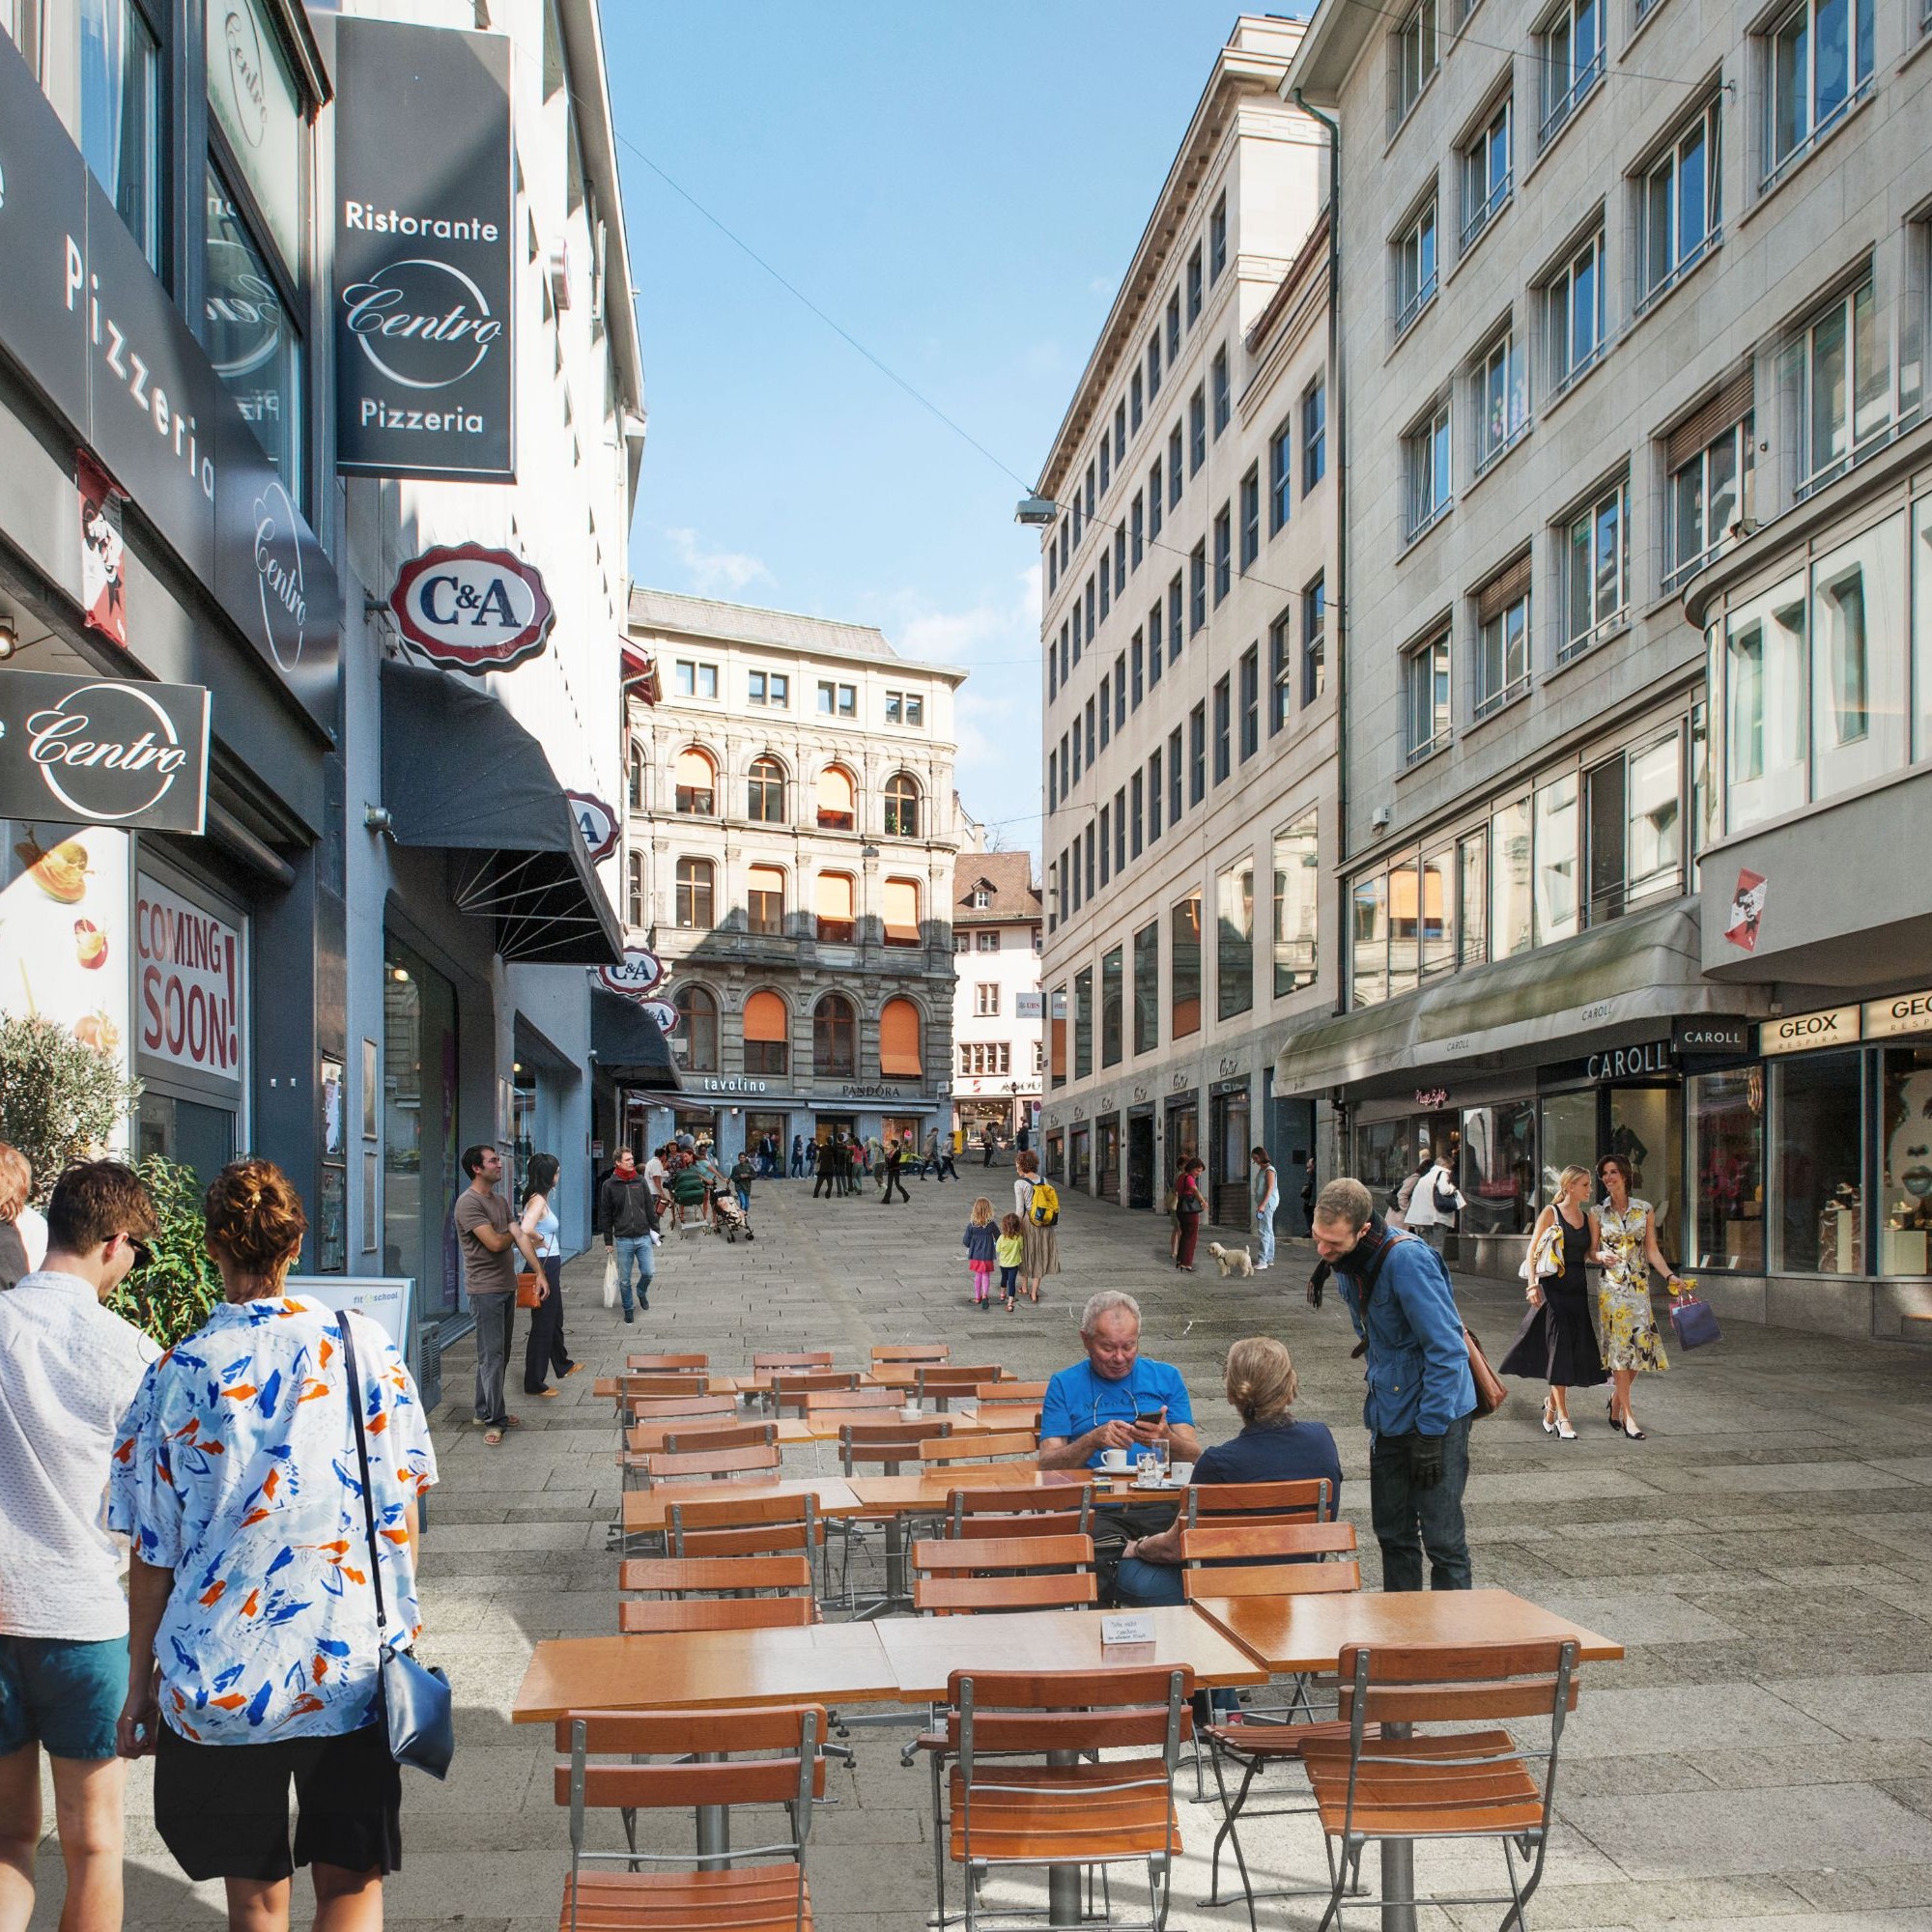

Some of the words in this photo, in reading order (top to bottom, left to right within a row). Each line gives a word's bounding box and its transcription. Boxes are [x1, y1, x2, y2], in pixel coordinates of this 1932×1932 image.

[345, 200, 498, 242] Ristorante
[342, 283, 502, 344] Centro
[65, 233, 215, 502] Pizzeria
[360, 397, 483, 433] Pizzeria
[253, 497, 306, 627] Centro
[420, 576, 522, 628] C&A
[27, 710, 186, 773] Centro
[137, 899, 221, 974] COMING
[143, 935, 239, 1069] SOON!
[1581, 1004, 1612, 1021] CAROLL
[1447, 1039, 1469, 1052] CAROLL
[1684, 1032, 1741, 1043] CAROLL
[1778, 1035, 1840, 1050] RESPIRA
[1779, 1014, 1838, 1038] GEOX
[1587, 1042, 1667, 1079] CAROLL
[704, 1077, 766, 1093] tavolino
